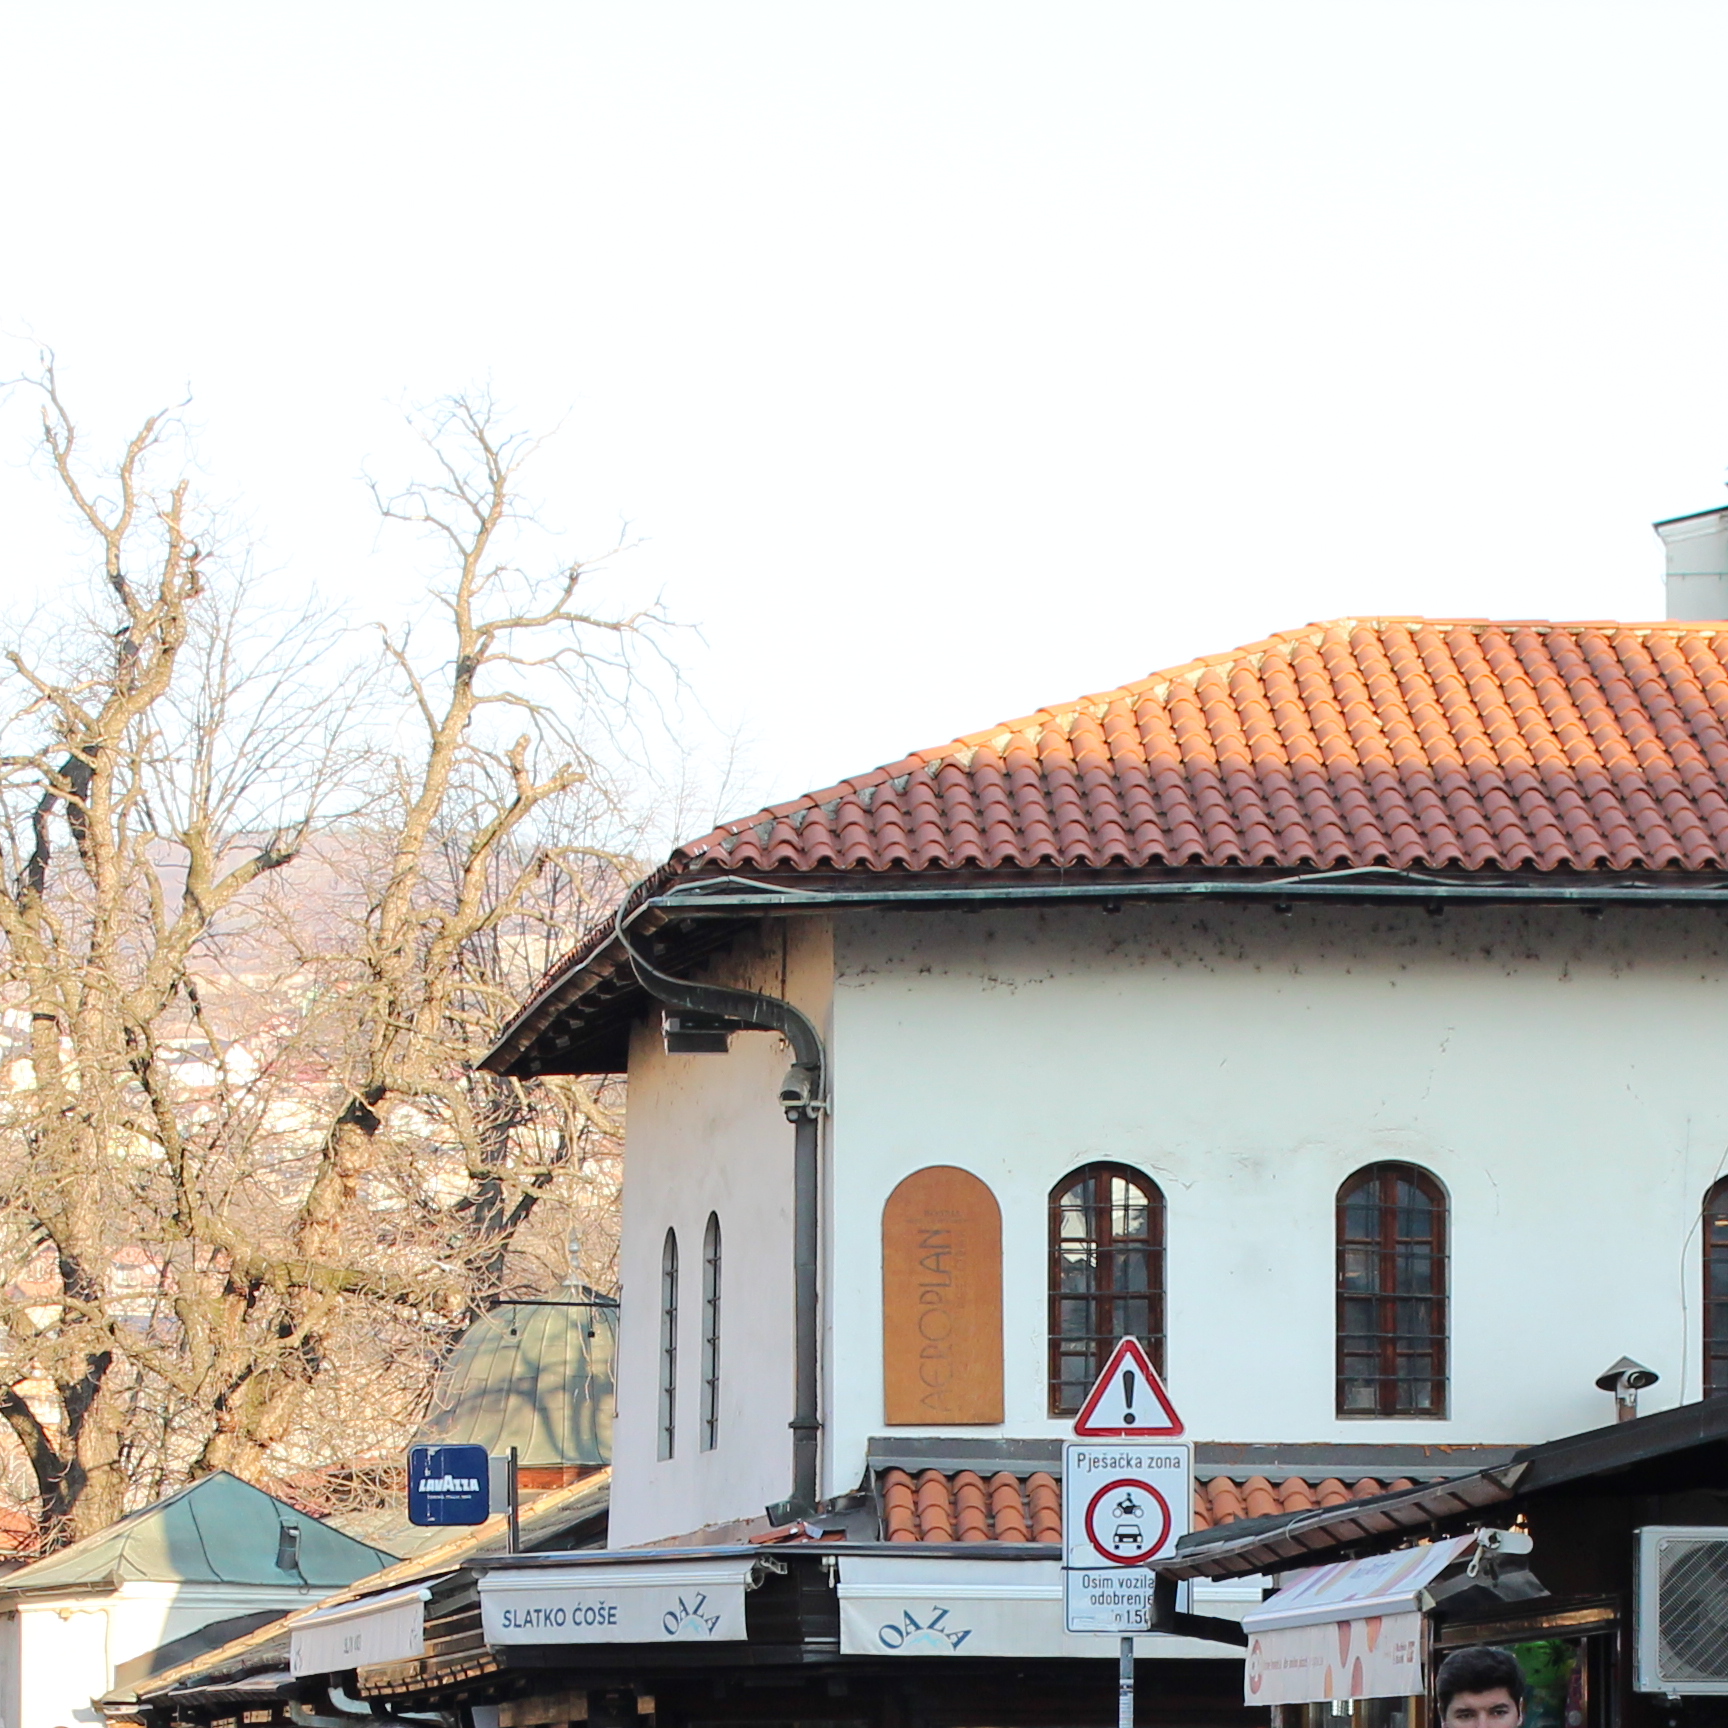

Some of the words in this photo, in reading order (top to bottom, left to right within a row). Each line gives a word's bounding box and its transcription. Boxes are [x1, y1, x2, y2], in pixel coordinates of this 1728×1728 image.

[1077, 1453, 1143, 1473] Pješačka
[1147, 1456, 1181, 1469] zona
[418, 1474, 480, 1493] LAVAZZA
[1082, 1575, 1113, 1589] Osim
[1118, 1574, 1155, 1589] vozila
[502, 1607, 567, 1629] SLATKO
[572, 1601, 618, 1626] ĆOŠE
[662, 1591, 722, 1637] OAZA
[878, 1605, 972, 1651] OAZA
